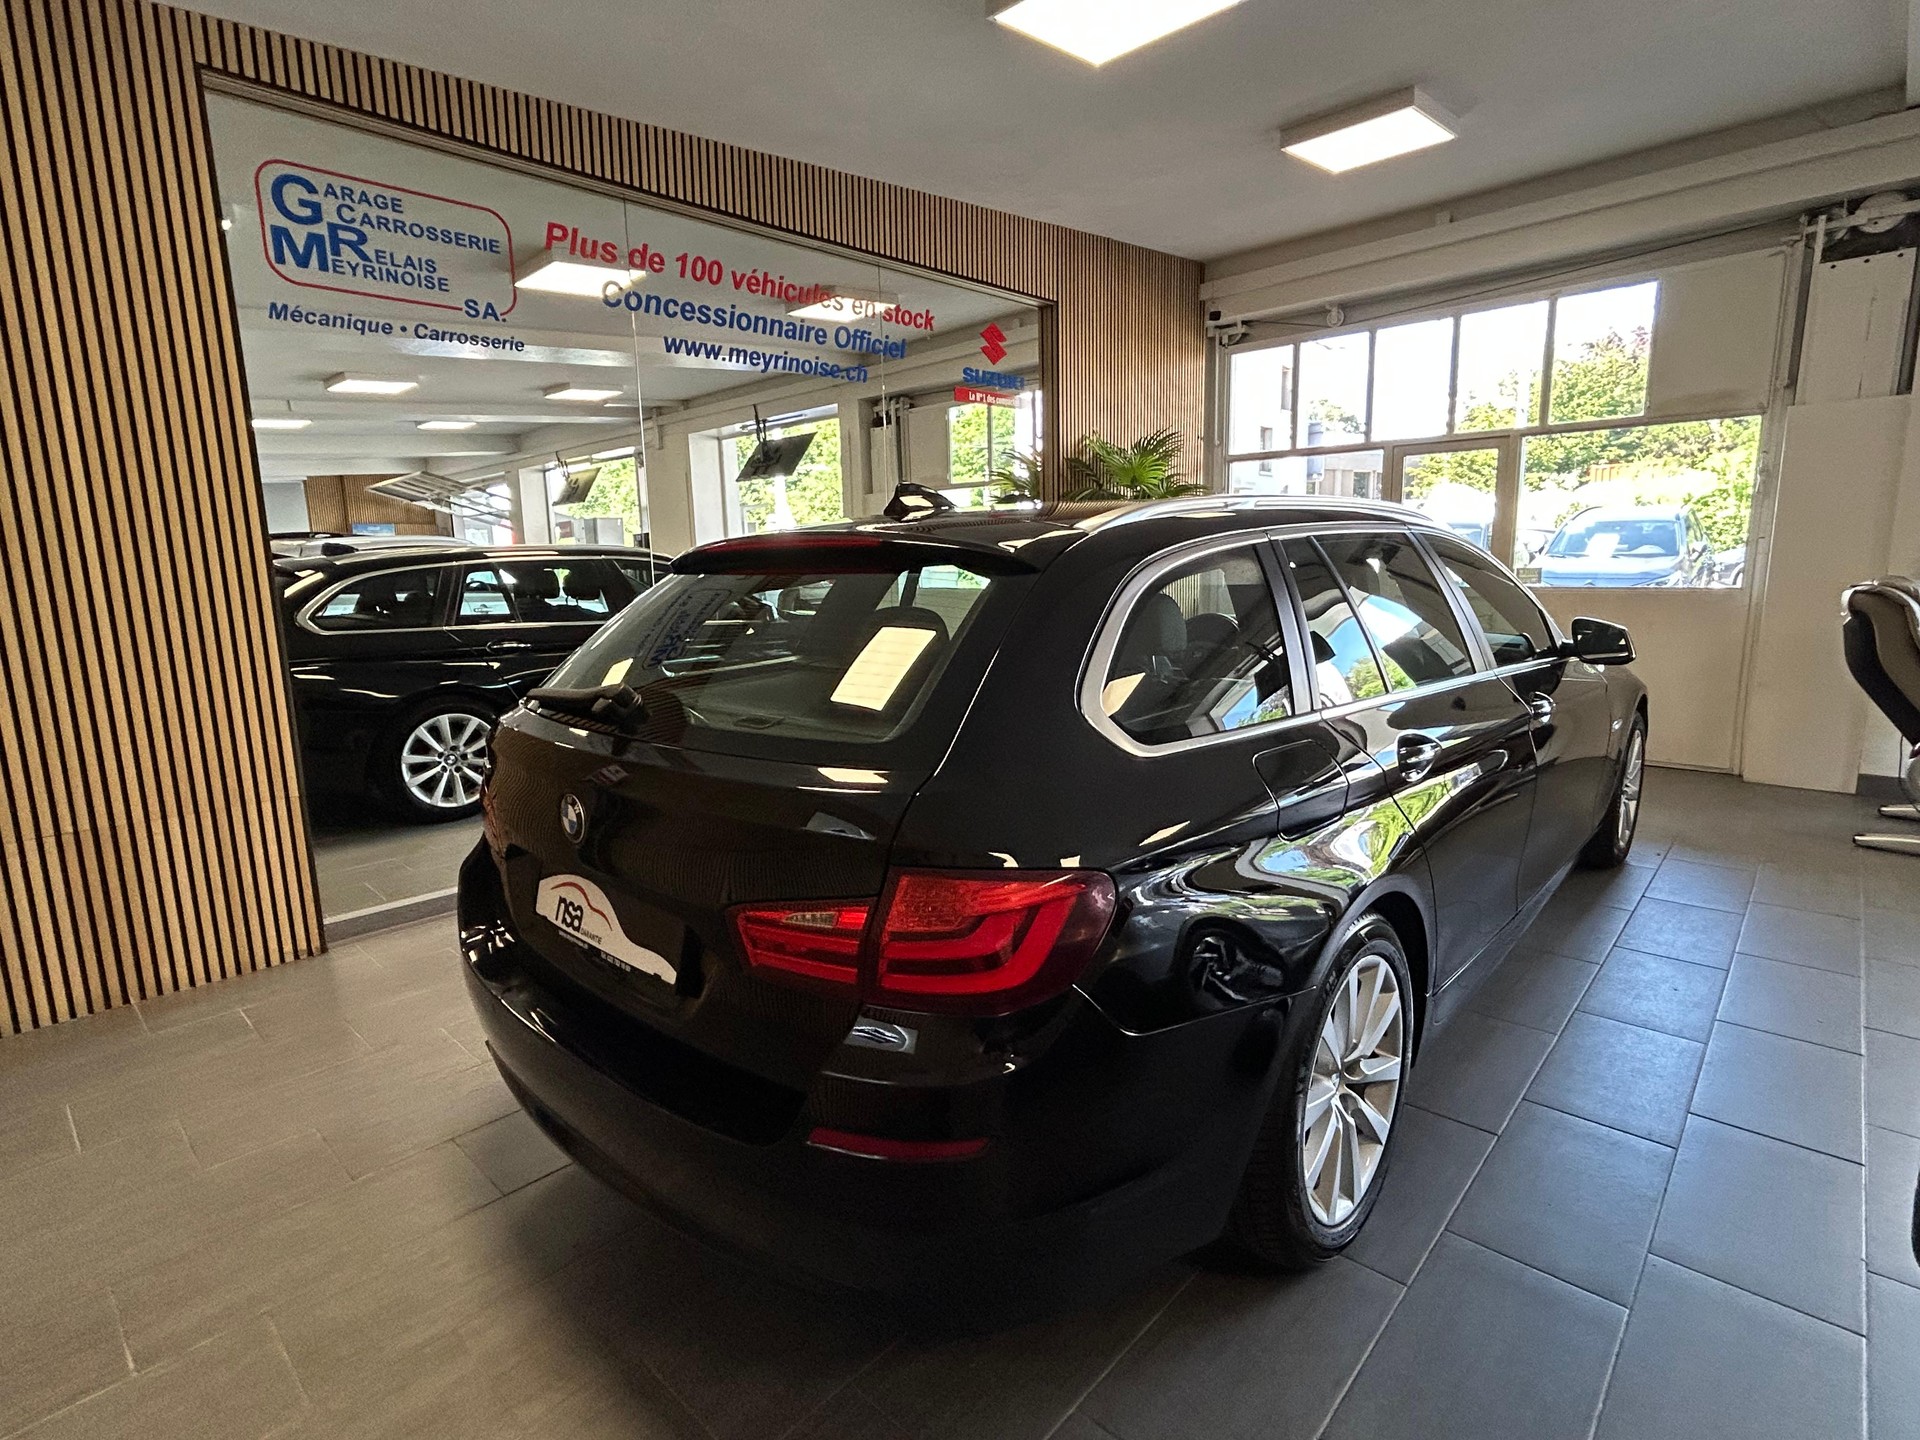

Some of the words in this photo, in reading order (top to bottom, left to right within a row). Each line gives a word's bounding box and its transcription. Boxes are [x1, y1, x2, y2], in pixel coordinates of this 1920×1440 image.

[270, 173, 403, 226] GARAGE
[326, 221, 437, 274] RELAIS
[336, 203, 501, 254] CARROSSERIE
[270, 224, 450, 292] MEYRINOISE
[545, 222, 618, 264] Plus
[628, 243, 665, 273] de
[675, 253, 723, 286] 100
[731, 268, 843, 312] véhicules
[852, 299, 876, 319] en
[882, 303, 935, 331] stock
[268, 301, 394, 335] Mécanique
[413, 323, 525, 352] Carrosserie
[601, 279, 827, 345] Concessionnaire
[834, 326, 906, 358] Officiel
[663, 336, 868, 384] www.meyrinoise.ch
[962, 366, 1025, 390] SUZUKI
